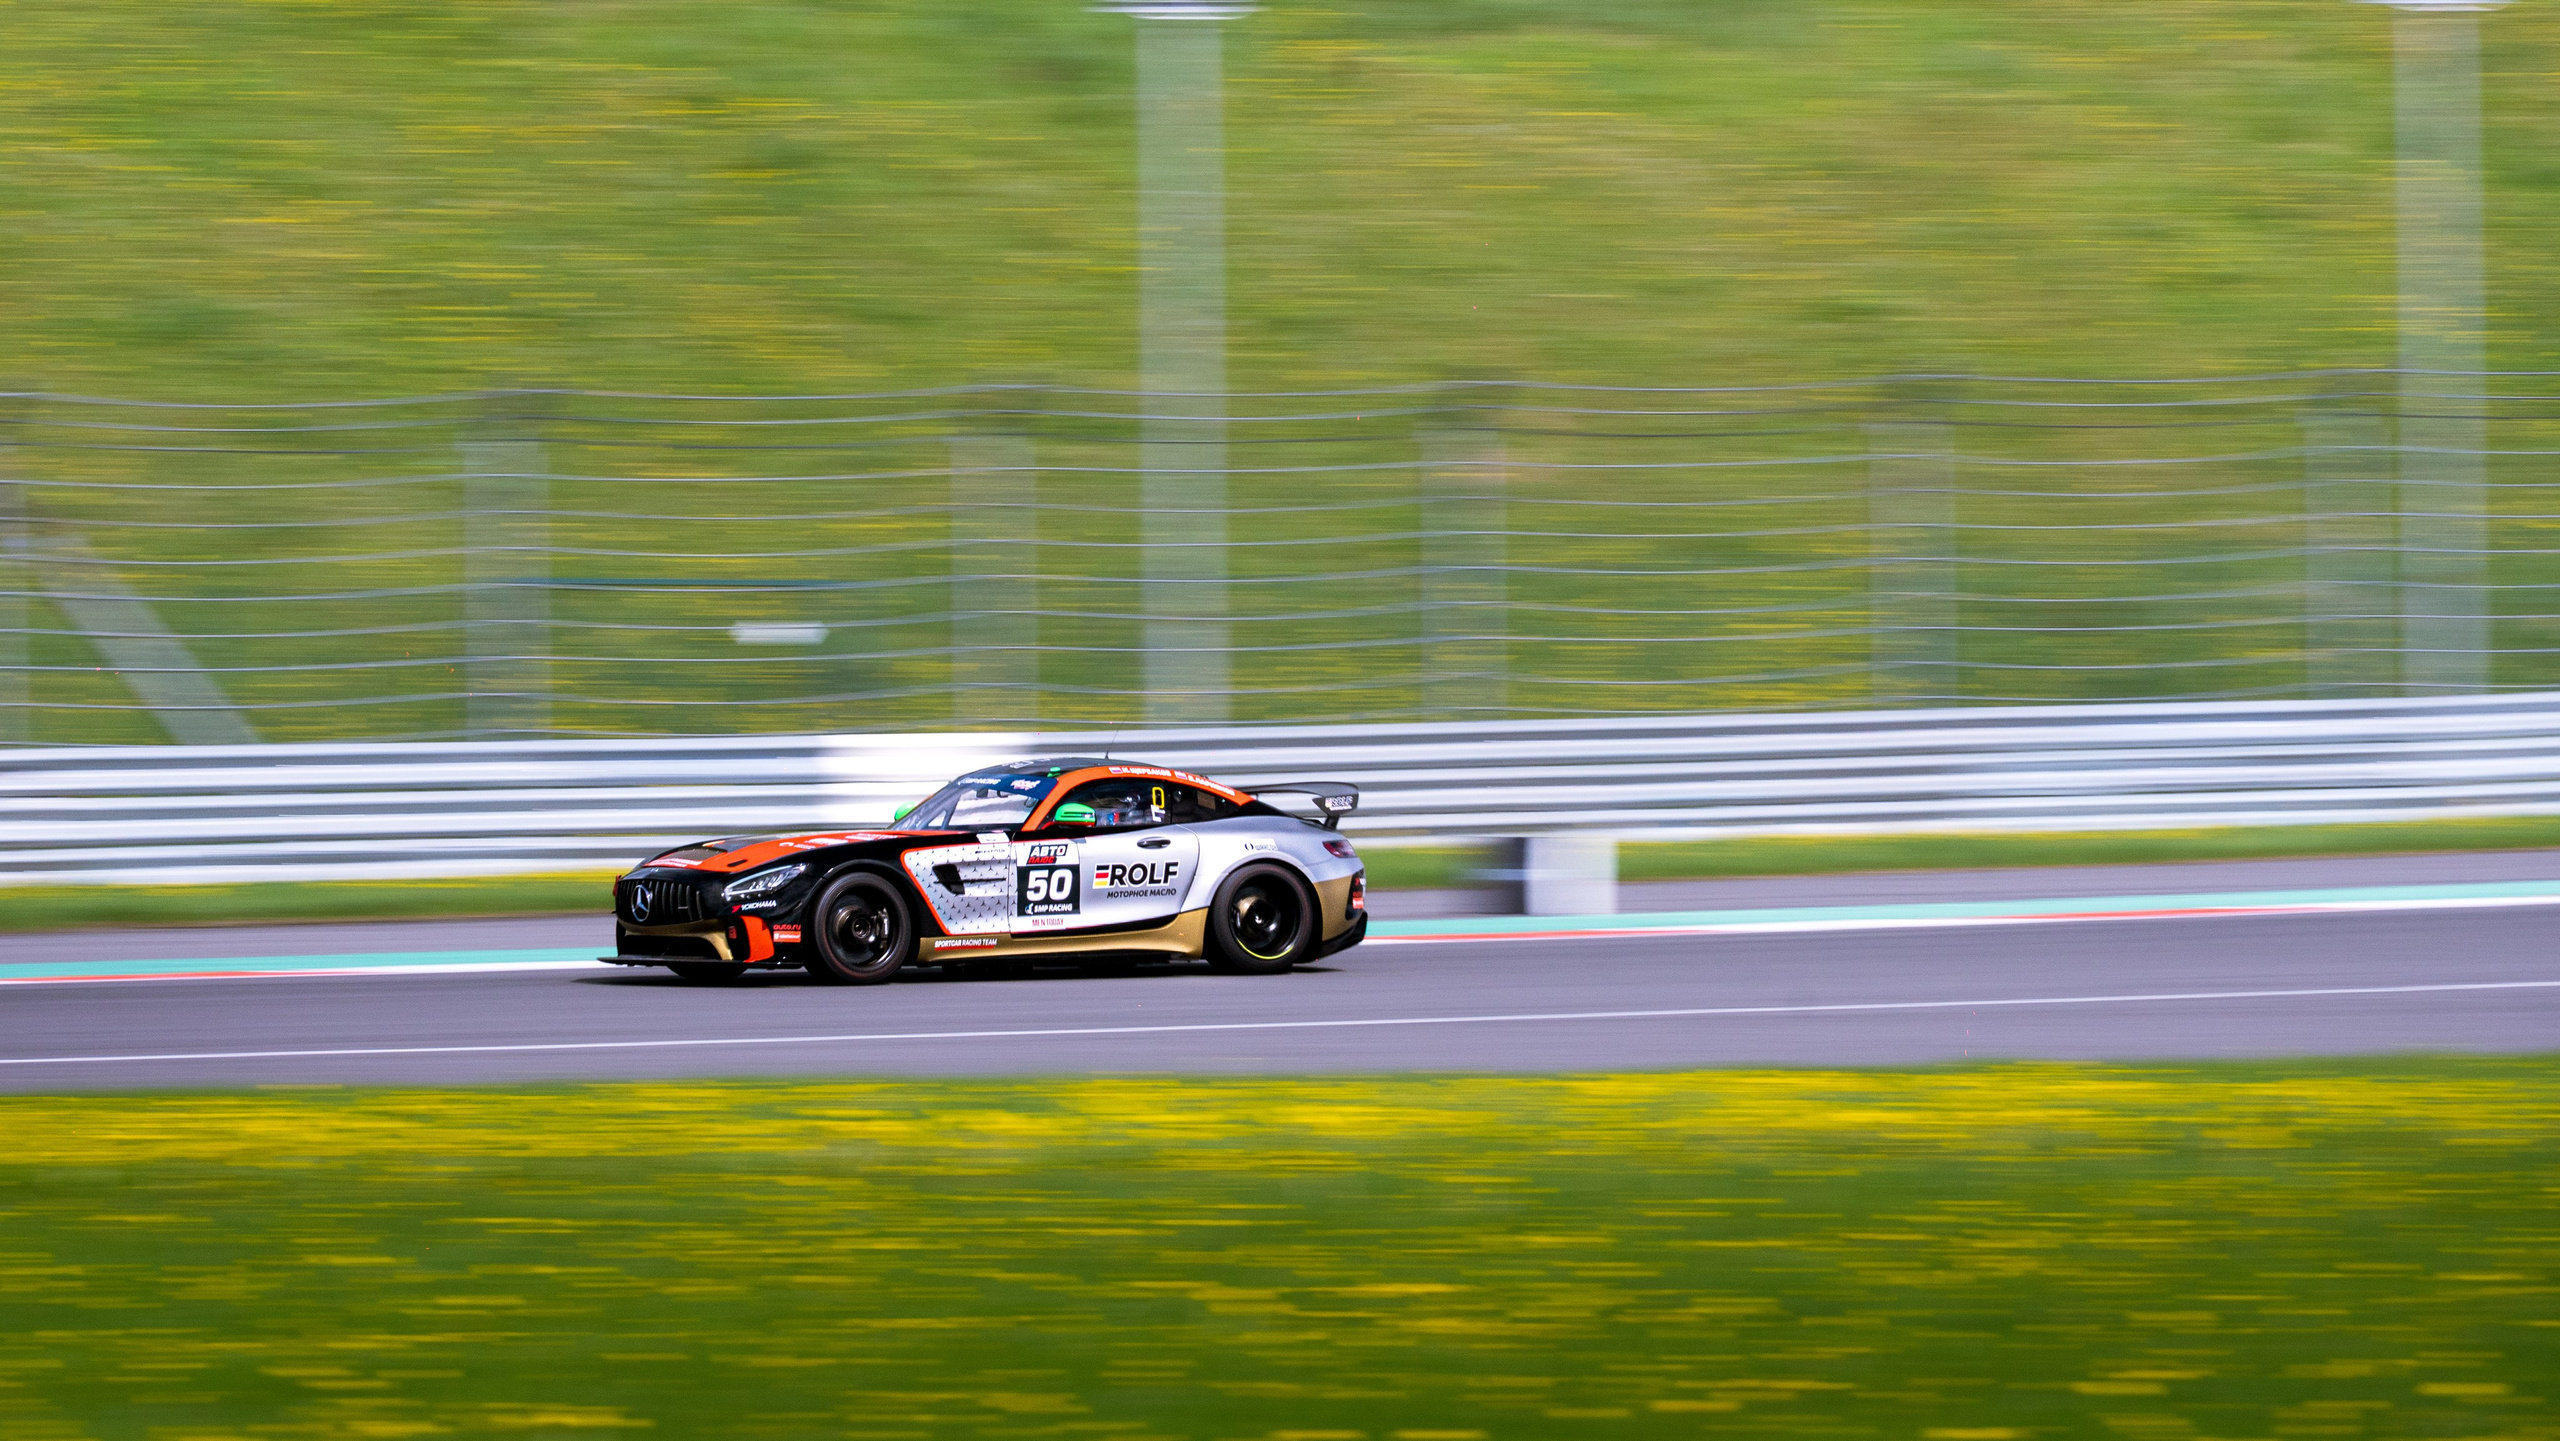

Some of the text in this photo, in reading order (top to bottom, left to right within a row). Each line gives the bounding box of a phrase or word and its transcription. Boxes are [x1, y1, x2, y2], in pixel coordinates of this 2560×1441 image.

[1030, 845, 1067, 857] АВТО
[1027, 856, 1055, 864] ПЛЮС
[1109, 862, 1178, 886] ROLF
[1026, 868, 1073, 901] 50
[1107, 888, 1177, 898] МОТОРНОЕ МАСЛО
[741, 900, 777, 911] YOKOHAMA
[1034, 903, 1073, 913] SMP RACING
[934, 938, 998, 948] SPORTCAR RACING TEAM
